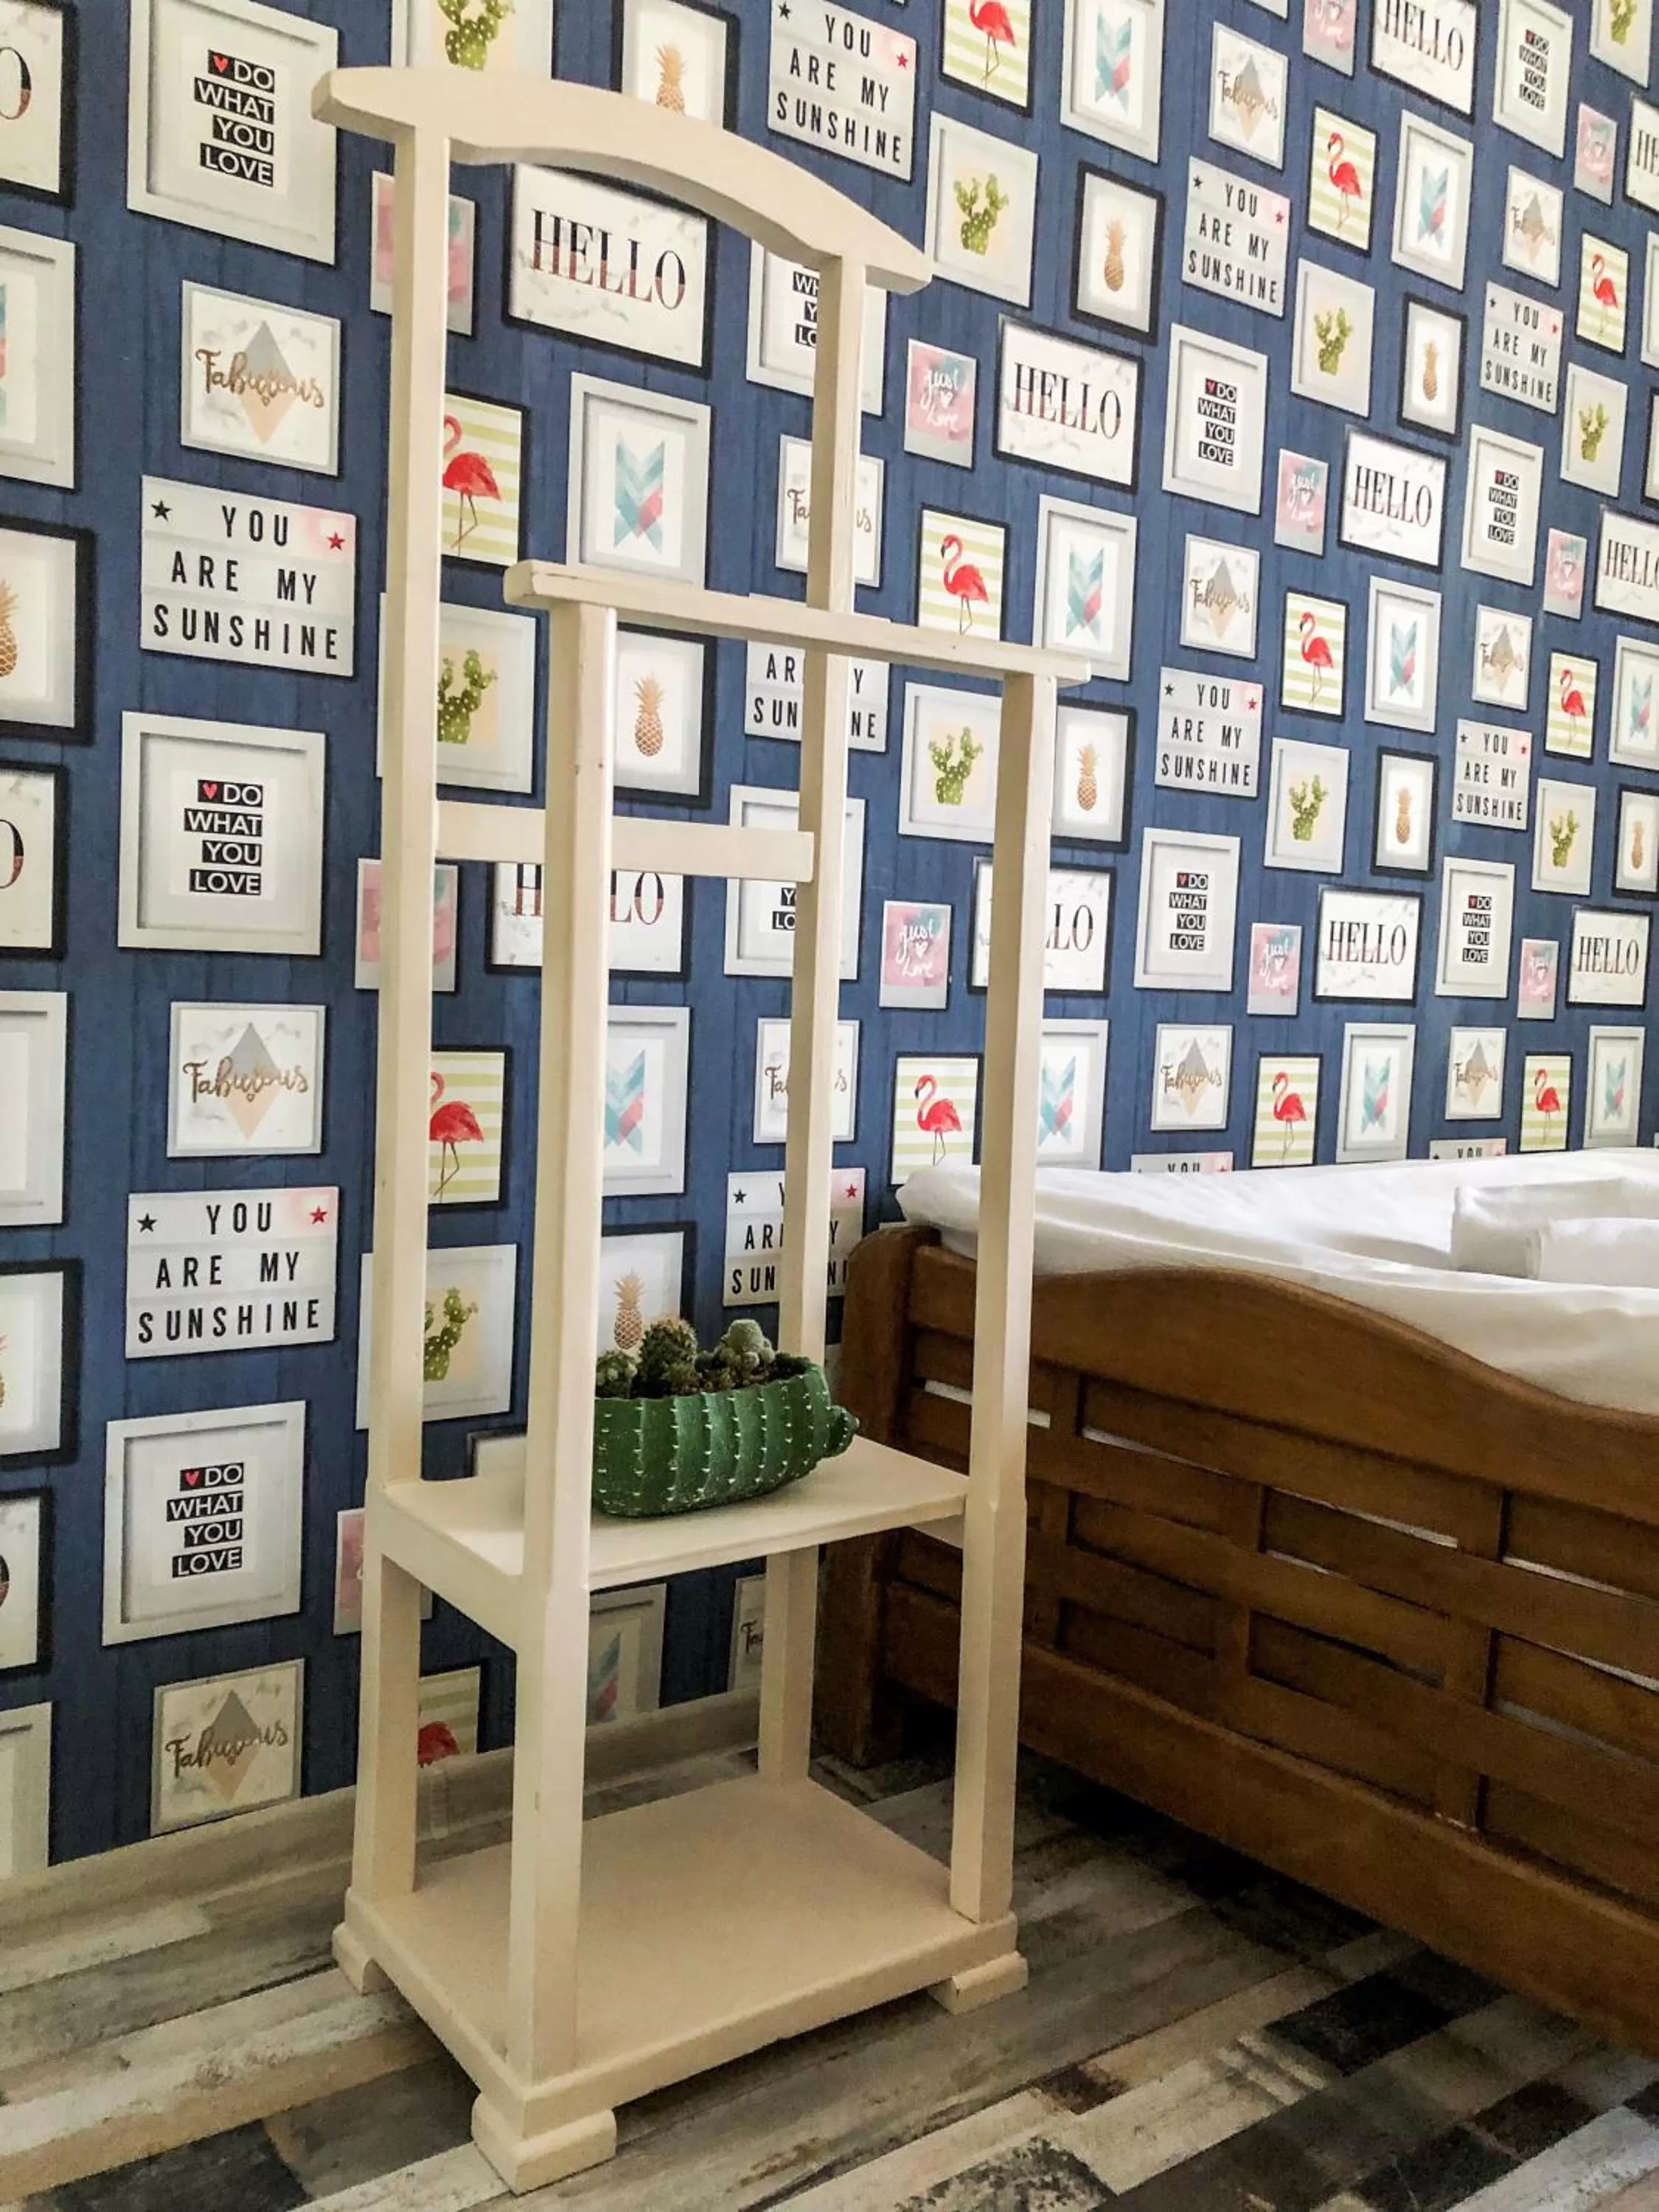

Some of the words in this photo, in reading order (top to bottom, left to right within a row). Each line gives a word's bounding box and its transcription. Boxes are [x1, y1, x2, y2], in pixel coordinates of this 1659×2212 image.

[825, 15, 871, 58] YOU
[1384, 0, 1463, 71] HELLO
[234, 62, 274, 89] DO
[790, 48, 836, 91] ARE
[861, 76, 891, 113] MY
[196, 80, 274, 122] WHAT
[216, 118, 274, 152] YOU
[777, 91, 901, 164] SUNSHINE
[206, 146, 273, 185] LOVE
[1225, 184, 1257, 218] YOU
[1199, 213, 1231, 246] ARE
[1248, 234, 1269, 262] MY
[532, 209, 686, 310] HELLO
[1189, 249, 1278, 304] SUNSHINE
[1514, 302, 1539, 330] YOU
[799, 327, 817, 347] LO
[1493, 327, 1519, 355] ARE
[1531, 343, 1547, 366] MY
[1217, 384, 1237, 402] DO
[1484, 360, 1552, 403] SUNSHINE
[1015, 363, 1121, 439] HELLO
[1200, 399, 1235, 423] WHAT
[1208, 422, 1234, 443] YOU
[1201, 442, 1233, 465] LOVE
[1353, 464, 1432, 527] HELLO
[222, 505, 288, 545] YOU
[172, 551, 239, 591] ARE
[276, 568, 317, 605] MY
[154, 605, 337, 659] SUNSHINE
[766, 653, 796, 684] AR
[1197, 684, 1230, 710] YOU
[753, 697, 876, 739] SUNNE
[1171, 717, 1204, 743] ARE
[1222, 725, 1242, 750] MY
[1484, 732, 1508, 755] YOU
[1162, 753, 1251, 787] SUNSHINE
[1464, 761, 1489, 784] ARE
[1501, 768, 1517, 789] MY
[223, 785, 262, 805] DO
[1457, 793, 1522, 821] SUNSHINE
[189, 812, 262, 836] WHAT
[206, 844, 260, 865] YOU
[195, 872, 260, 895] LOVE
[1189, 872, 1208, 889] DO
[1172, 892, 1206, 910] WHAT
[776, 913, 796, 929] LO
[1178, 914, 1205, 931] YOU
[1171, 934, 1204, 951] LOVE
[1328, 919, 1406, 966] HELLO
[1578, 936, 1638, 975] HELLO
[183, 1055, 308, 1103] Fabulous
[206, 1203, 272, 1235] YOU
[156, 1255, 223, 1288] ARE
[260, 1252, 299, 1282] MY
[139, 1298, 319, 1343] SUNSHINE
[205, 1465, 243, 1487] DO
[170, 1492, 243, 1520] WHAT
[188, 1521, 242, 1545] YOU
[178, 1550, 241, 1577] LOVE
